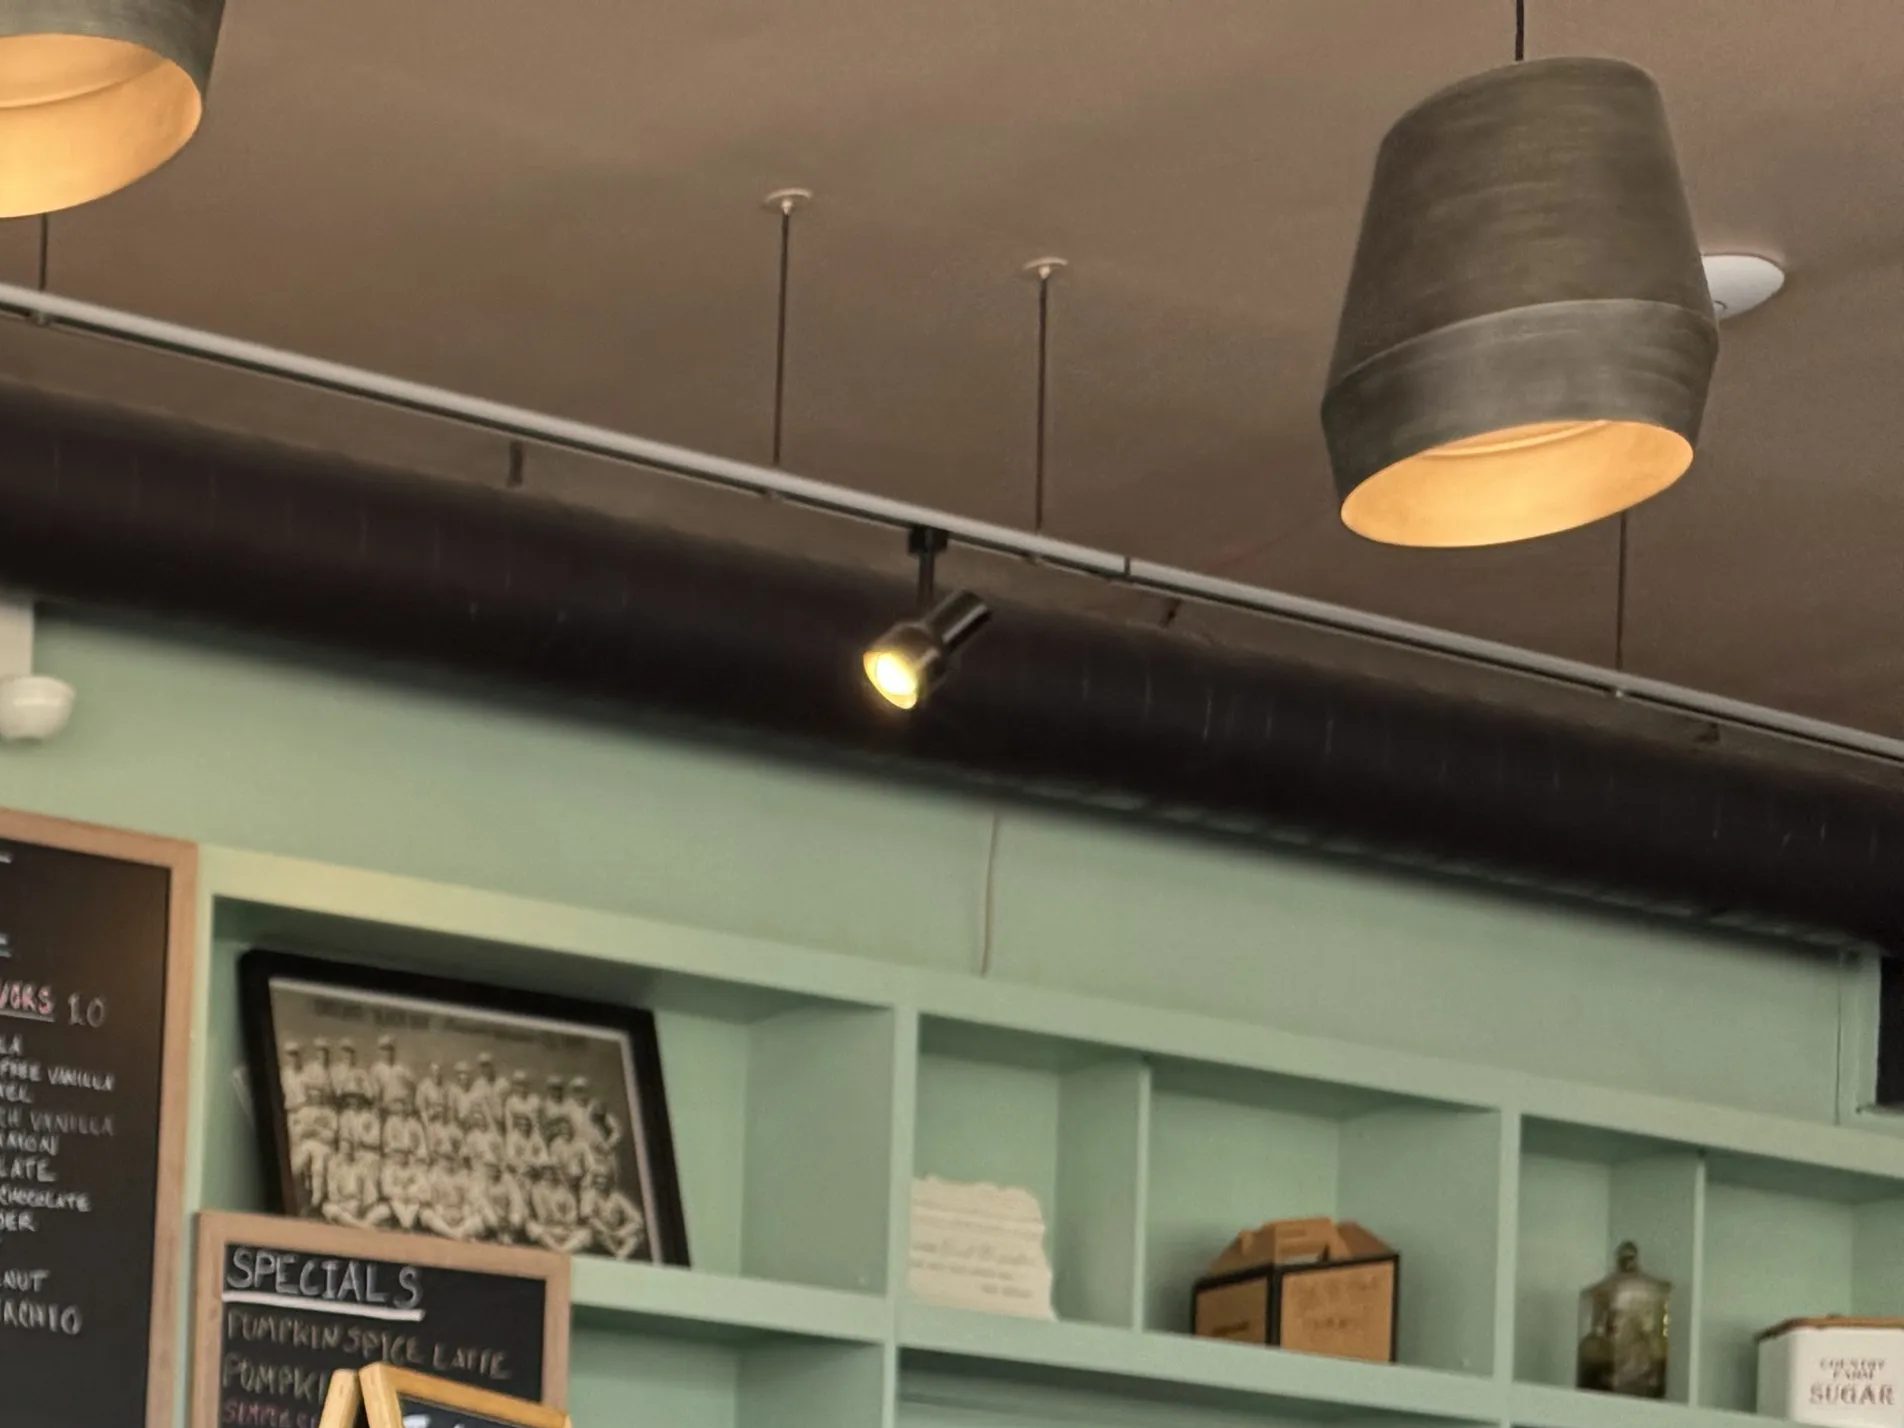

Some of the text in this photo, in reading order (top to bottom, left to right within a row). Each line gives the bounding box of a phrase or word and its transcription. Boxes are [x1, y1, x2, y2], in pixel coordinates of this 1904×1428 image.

[48, 1066, 116, 1092] VANILLA
[31, 1111, 115, 1137] VANILLA
[226, 1247, 423, 1309] SPECIALS
[227, 1308, 340, 1350] PUMPKIN
[343, 1324, 424, 1362] SPICE
[1809, 1383, 1896, 1405] SUGAR
